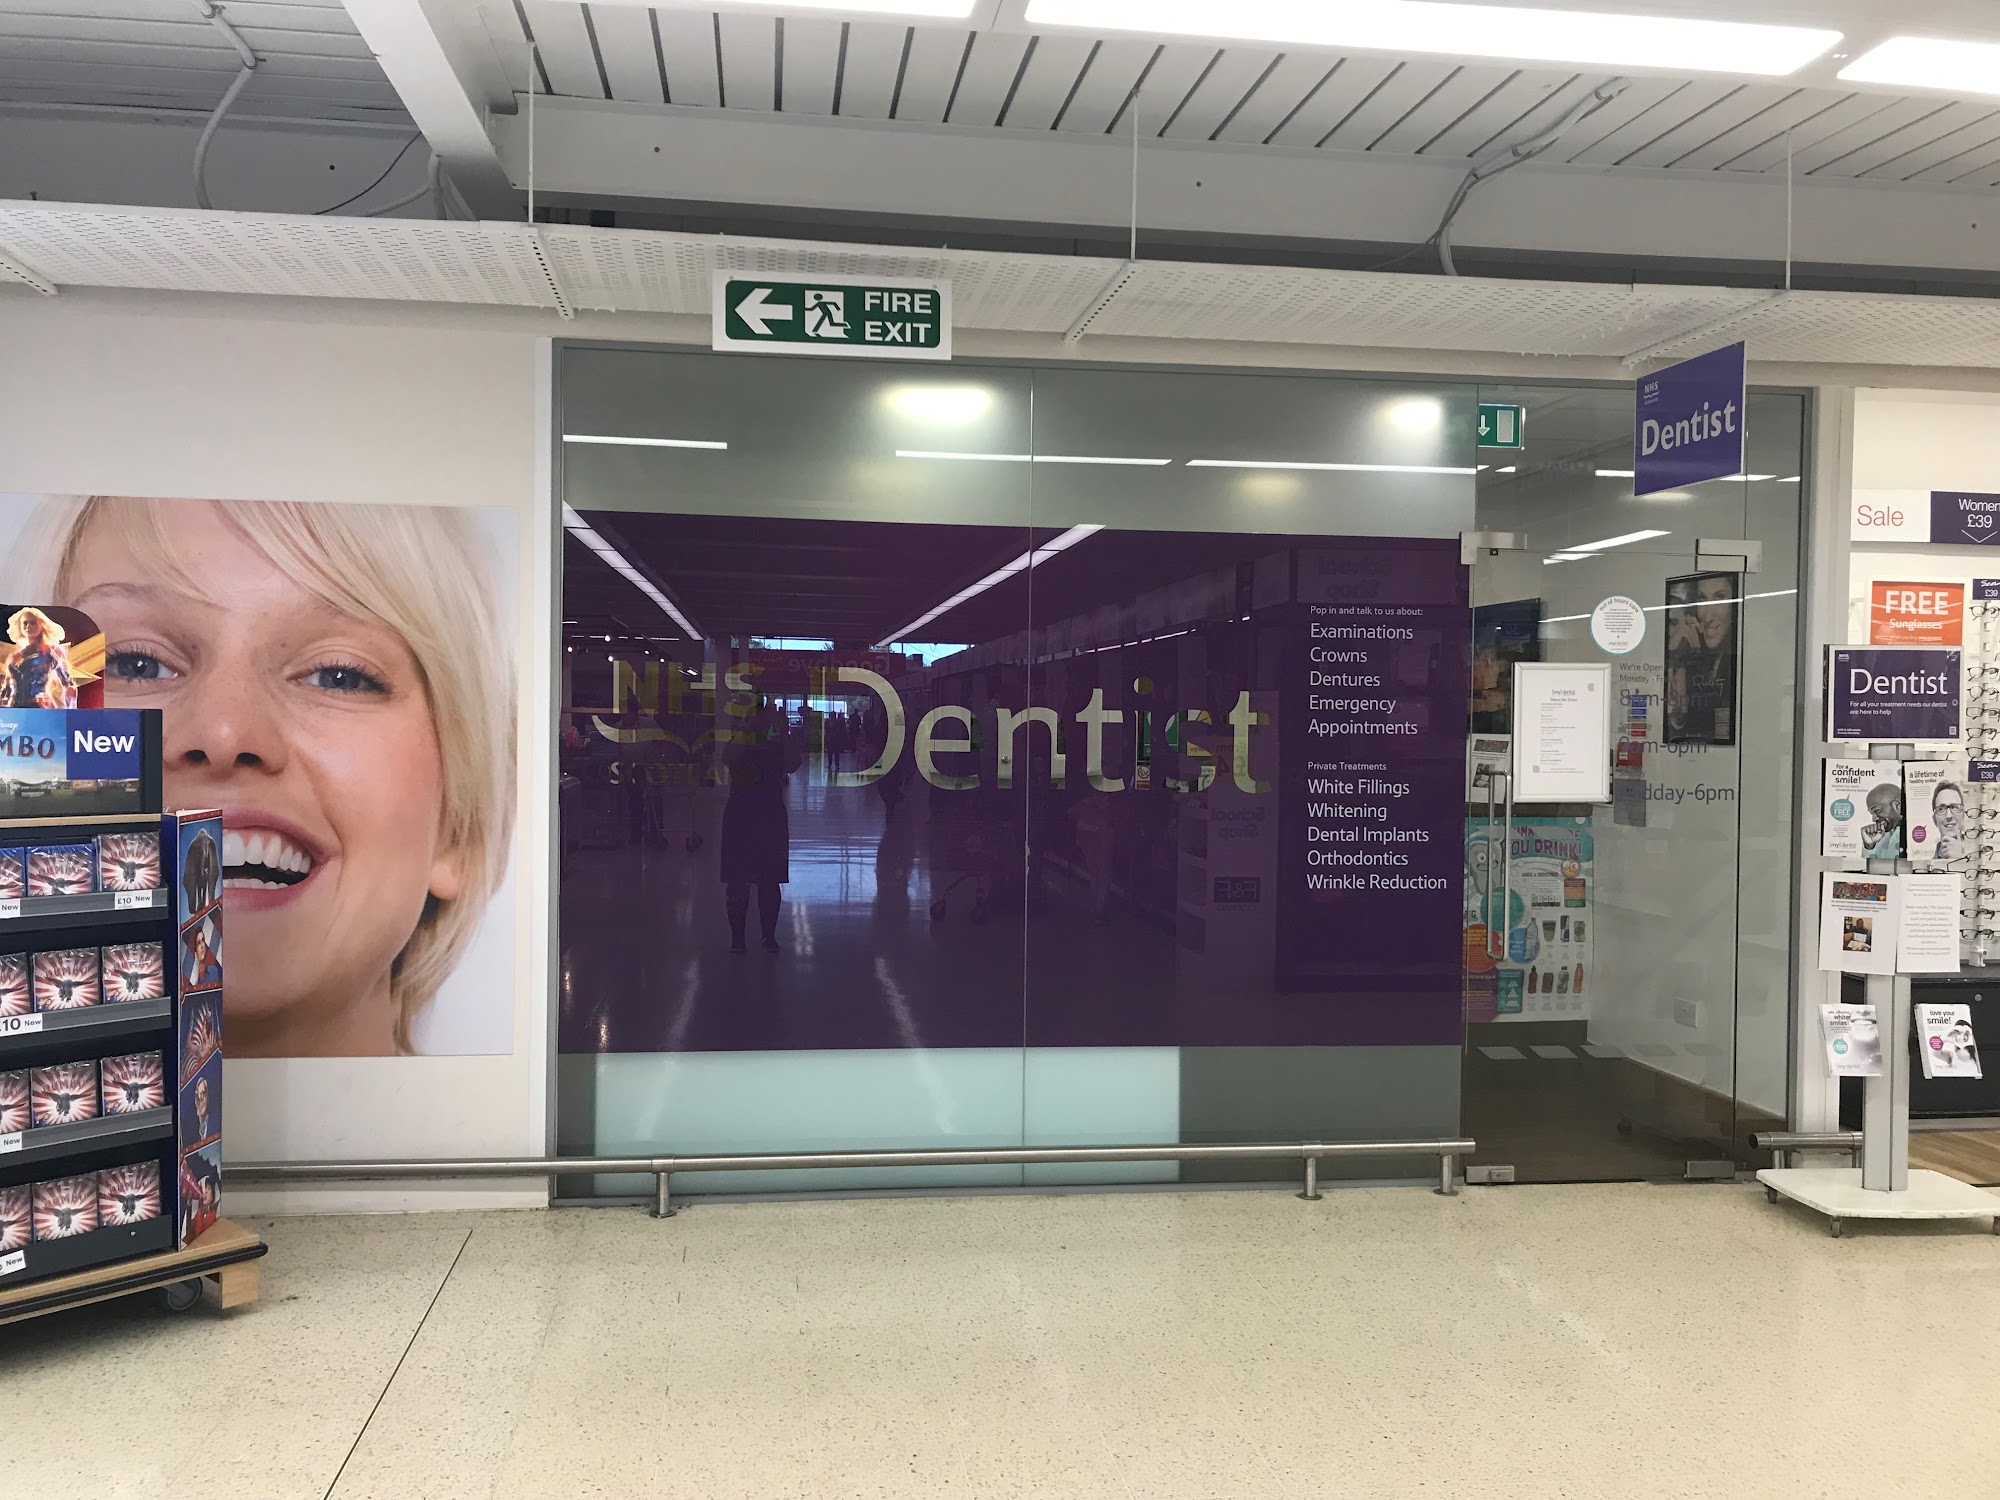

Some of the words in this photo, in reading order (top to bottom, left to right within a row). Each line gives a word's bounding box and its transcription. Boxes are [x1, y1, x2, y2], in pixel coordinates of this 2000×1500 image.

[864, 291, 932, 314] FIRE
[864, 320, 932, 343] EXIT
[1644, 381, 1659, 394] NHS
[1642, 400, 1736, 456] Dentist
[1857, 504, 1904, 527] Sale
[1967, 514, 1993, 528] £39
[1985, 589, 1998, 597] £39
[1885, 590, 1949, 615] FREE
[1310, 606, 1327, 616] Pop
[1329, 606, 1337, 614] in
[1339, 607, 1354, 615] and
[1356, 607, 1372, 615] talk
[1396, 607, 1423, 616] about:
[1310, 622, 1413, 640] Examinations
[1889, 618, 1943, 632] Sunglasses
[1310, 646, 1368, 663] Crowns
[1619, 662, 1641, 672] We're
[1642, 662, 1663, 674] Open
[1309, 670, 1381, 687] Dentures
[1619, 673, 1650, 685] Monday
[1850, 668, 1948, 695] Dentist
[612, 660, 761, 718] NHS
[1309, 694, 1397, 714] Emergency
[811, 666, 1272, 794] Dentist
[1308, 718, 1418, 737] Appointments
[74, 730, 135, 753] New
[1307, 761, 1337, 771] Private
[1339, 761, 1387, 771] Treatments
[1831, 767, 1875, 777] confident
[1914, 770, 1937, 778] lifetime
[1835, 776, 1861, 784] smile!
[1980, 771, 1994, 779] £39
[1307, 778, 1354, 794] White
[1358, 779, 1410, 797] Fillings
[1307, 802, 1387, 822] Whitening
[1307, 826, 1359, 843] Dental
[1363, 826, 1429, 845] Implants
[1307, 850, 1409, 866] Orthodontics
[1306, 874, 1365, 889] Wrinkle
[1369, 874, 1447, 889] Reduction
[0, 1018, 21, 1032] 10
[1927, 1017, 1951, 1025] smile!
[3, 1138, 21, 1146] New
[6, 1256, 23, 1266] New
